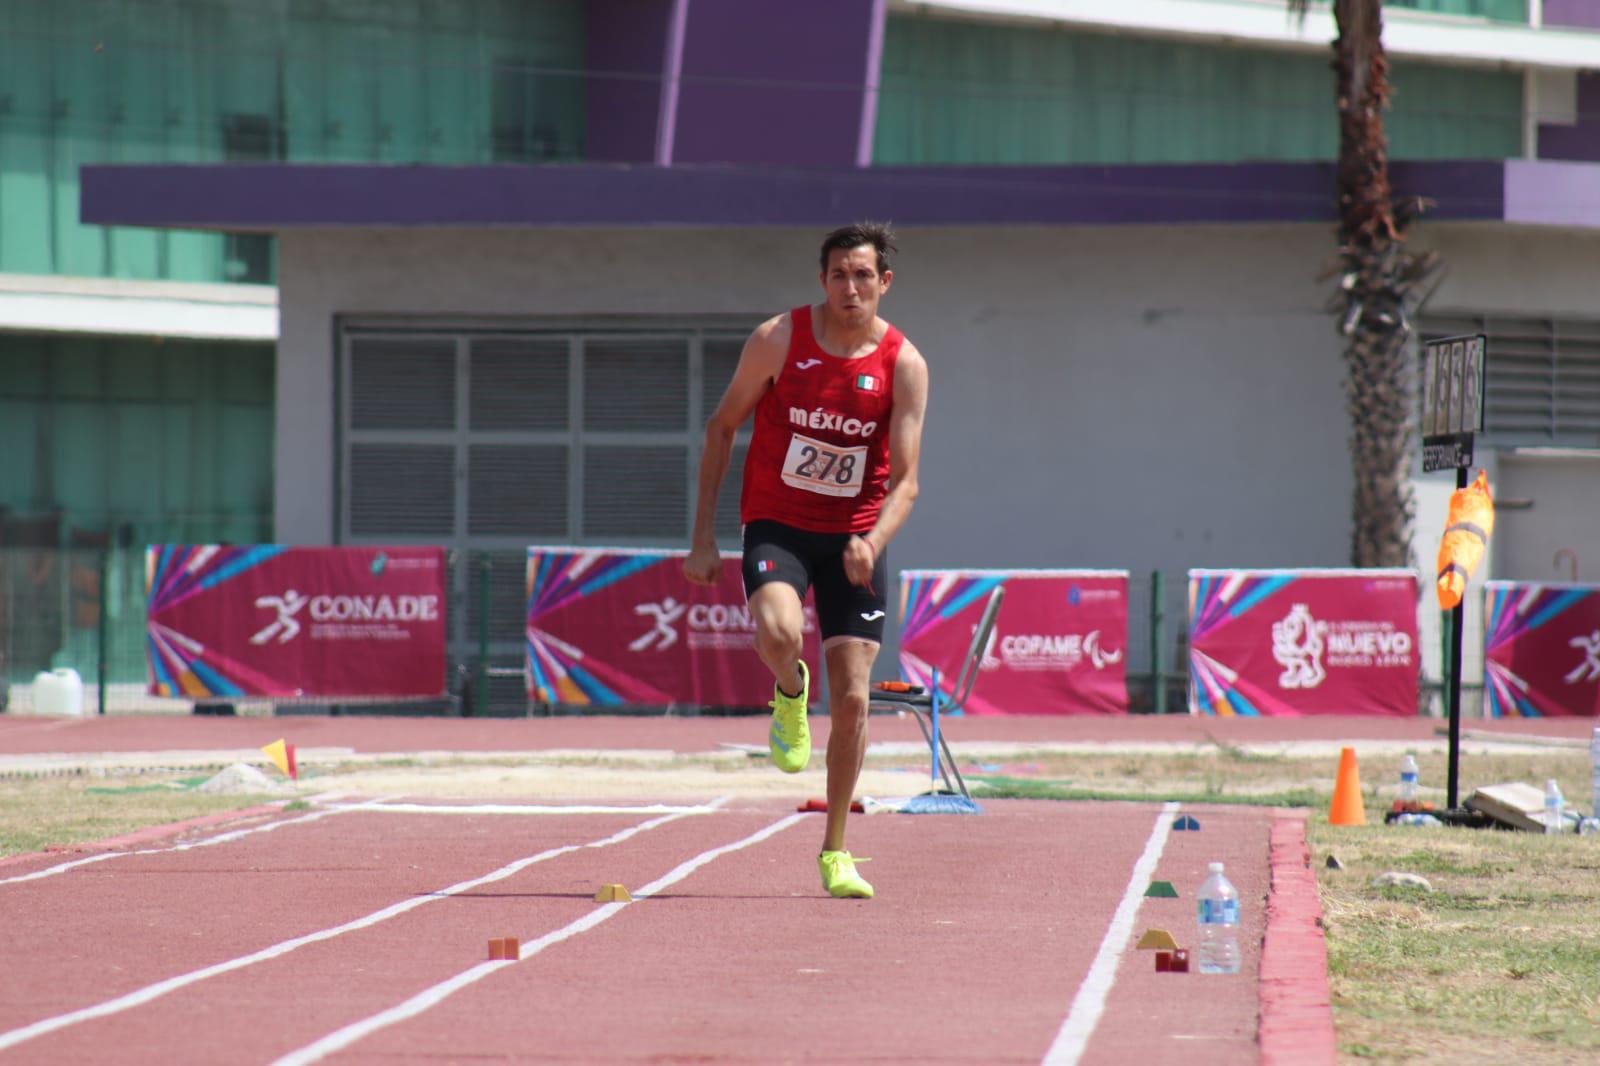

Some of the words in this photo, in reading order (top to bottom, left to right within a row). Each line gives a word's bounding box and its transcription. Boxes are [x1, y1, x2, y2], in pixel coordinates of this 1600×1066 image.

[788, 407, 878, 437] MÉXICO
[795, 446, 857, 485] 278
[309, 595, 439, 621] CONADE
[1000, 634, 1082, 656] COPAME
[1327, 631, 1412, 655] NUEVO
